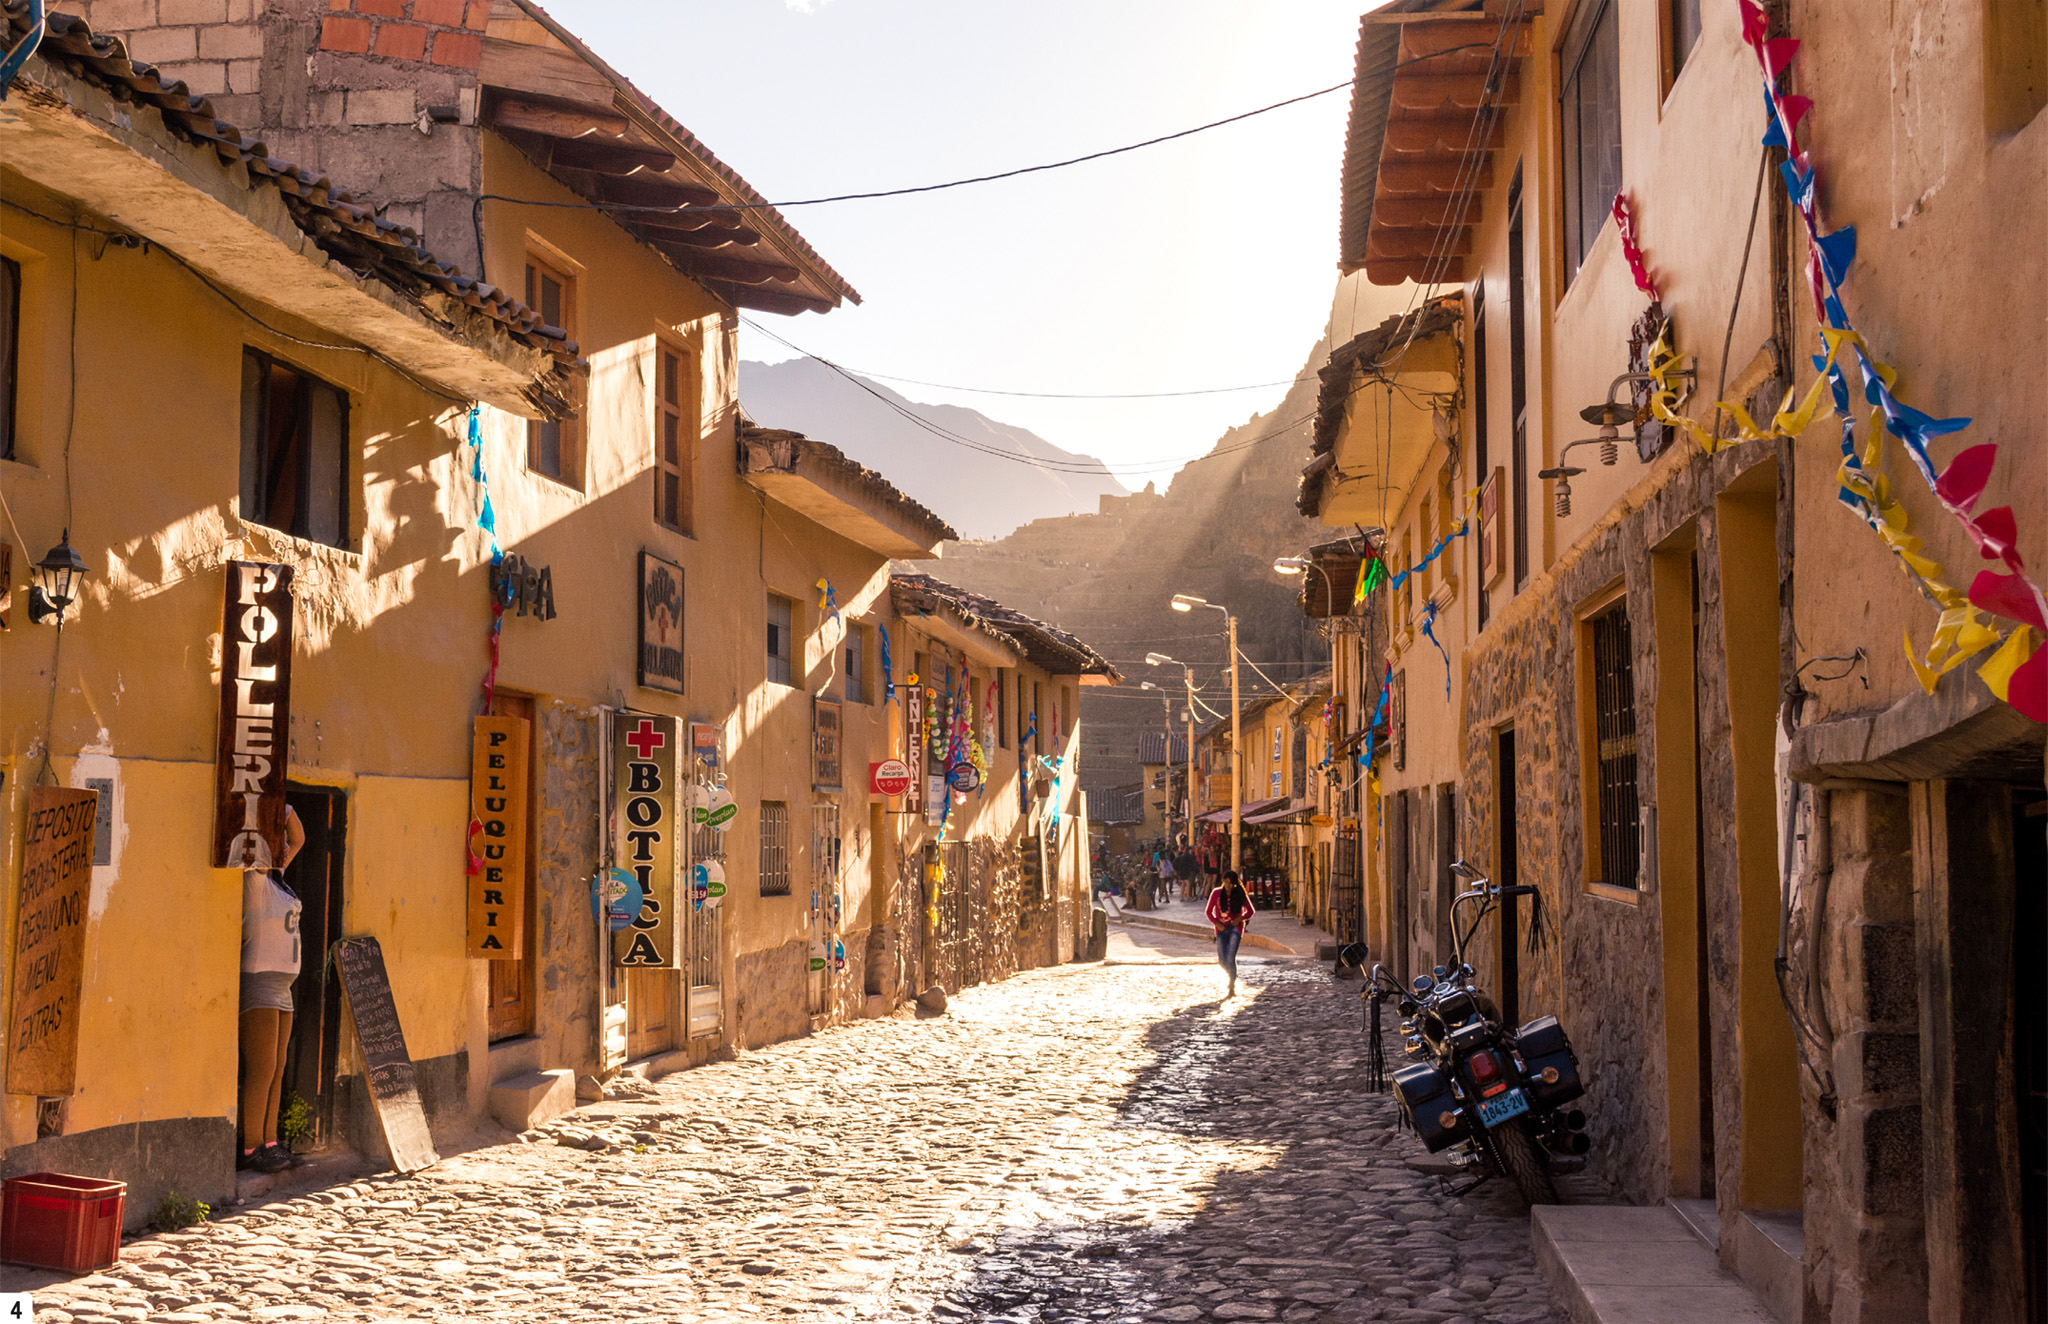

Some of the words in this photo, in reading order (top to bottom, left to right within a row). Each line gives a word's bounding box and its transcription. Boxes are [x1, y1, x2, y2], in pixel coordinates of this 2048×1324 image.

[228, 565, 280, 868] POLLERIA
[883, 764, 902, 772] Claro
[908, 687, 920, 812] INTERNET
[26, 798, 97, 846] DEPOSITO
[480, 731, 508, 950] PELUQUERIA
[621, 762, 665, 965] BOTICA
[20, 890, 81, 954] DESAYUNO
[17, 995, 64, 1053] EXTRAS
[1482, 1092, 1525, 1123] 1843-2V
